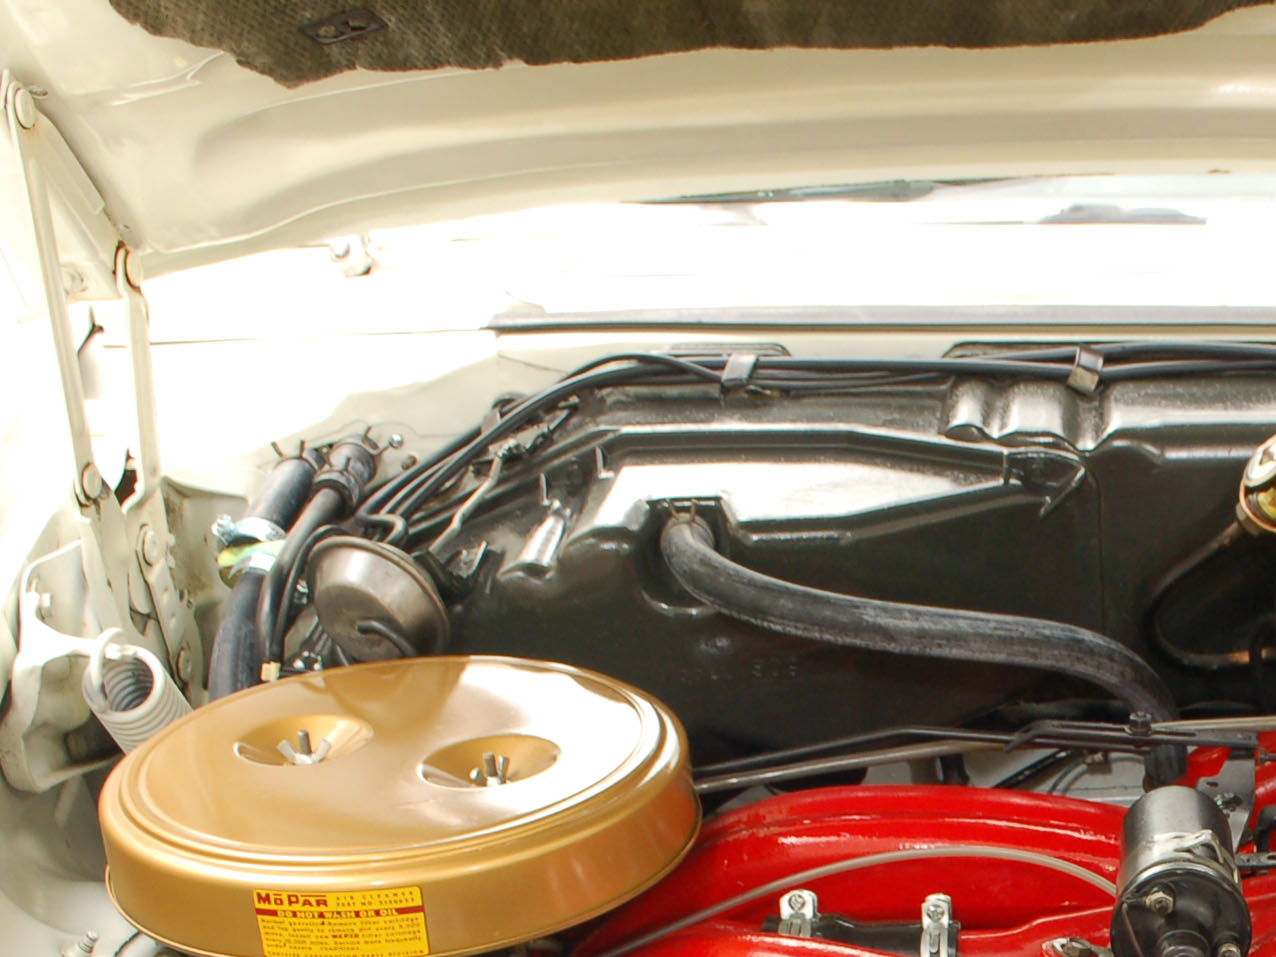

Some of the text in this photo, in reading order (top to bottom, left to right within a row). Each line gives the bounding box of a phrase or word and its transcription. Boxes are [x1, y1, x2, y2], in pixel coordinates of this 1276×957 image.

[276, 907, 400, 919] DO NOT WASH OR OIL
